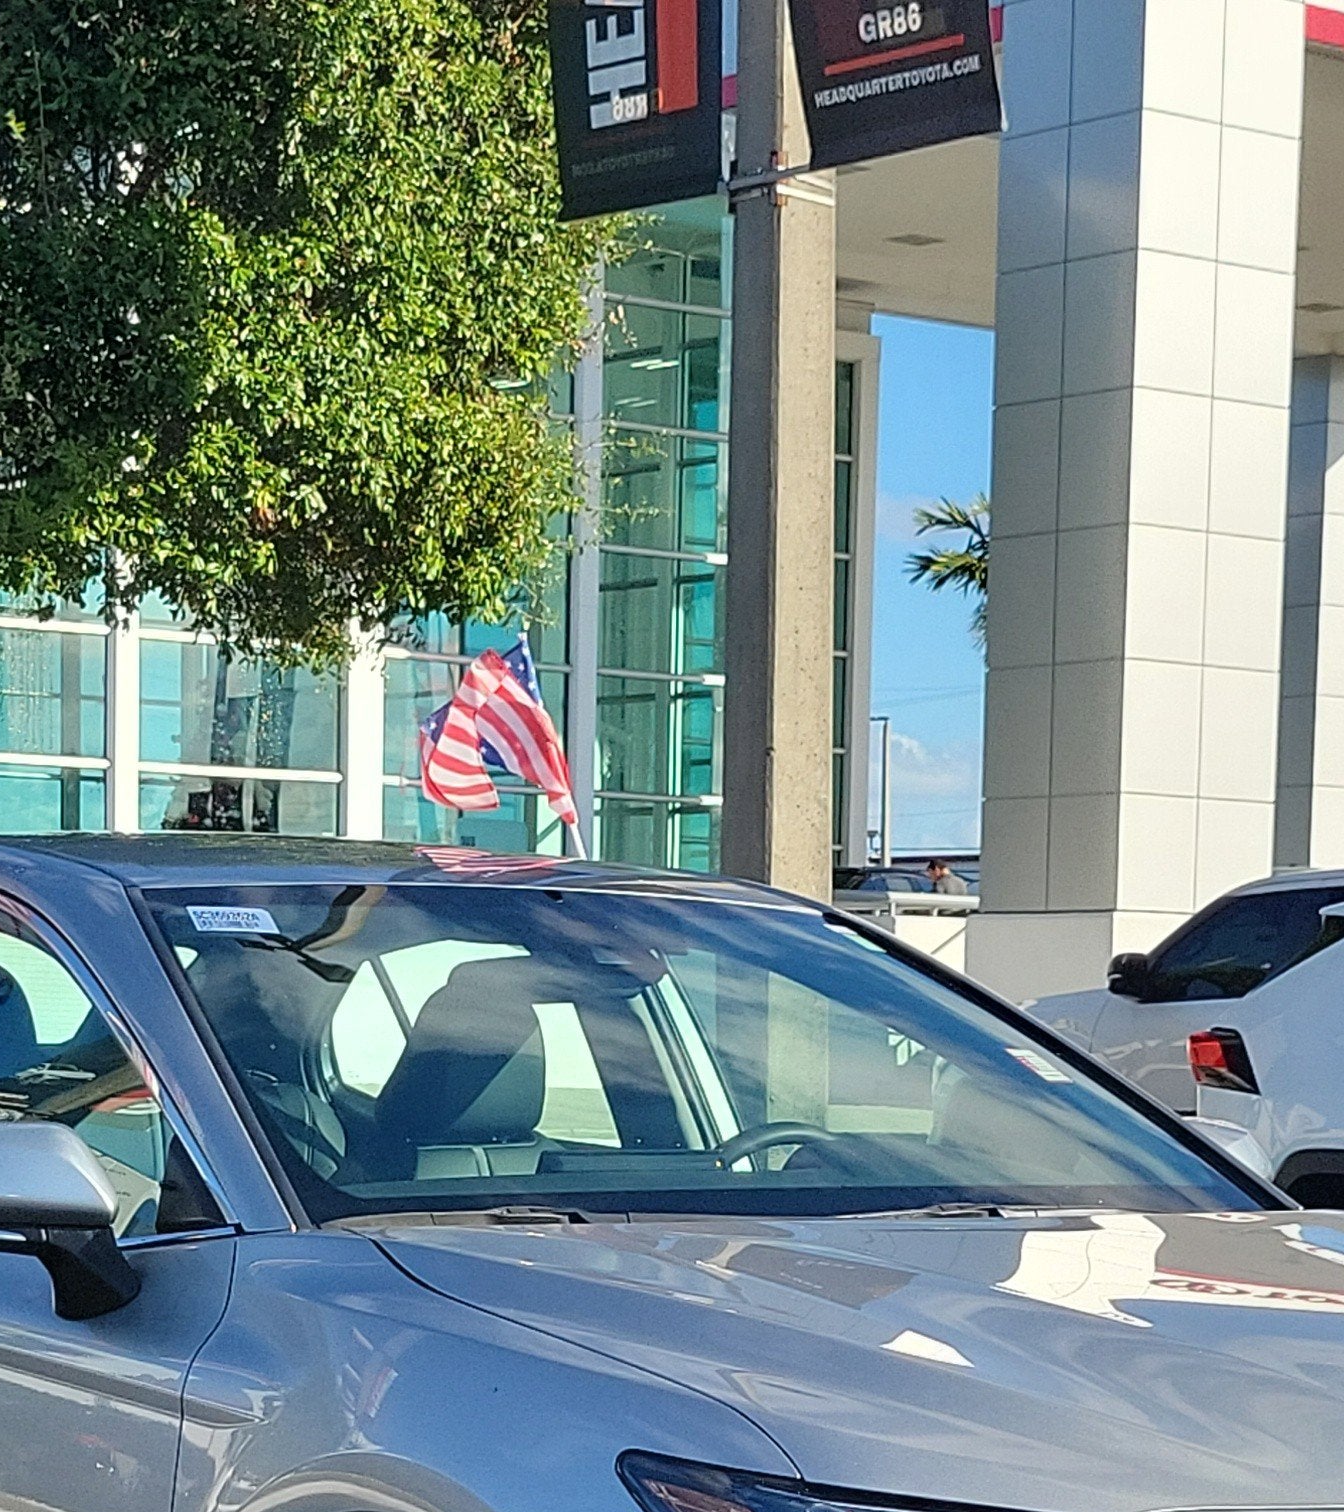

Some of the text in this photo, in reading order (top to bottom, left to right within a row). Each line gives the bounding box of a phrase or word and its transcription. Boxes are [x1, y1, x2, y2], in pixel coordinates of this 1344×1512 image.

[858, 2, 922, 43] GR86
[583, 0, 647, 129] HE
[813, 53, 981, 109] HEADQUARTERTOYOTA.COM
